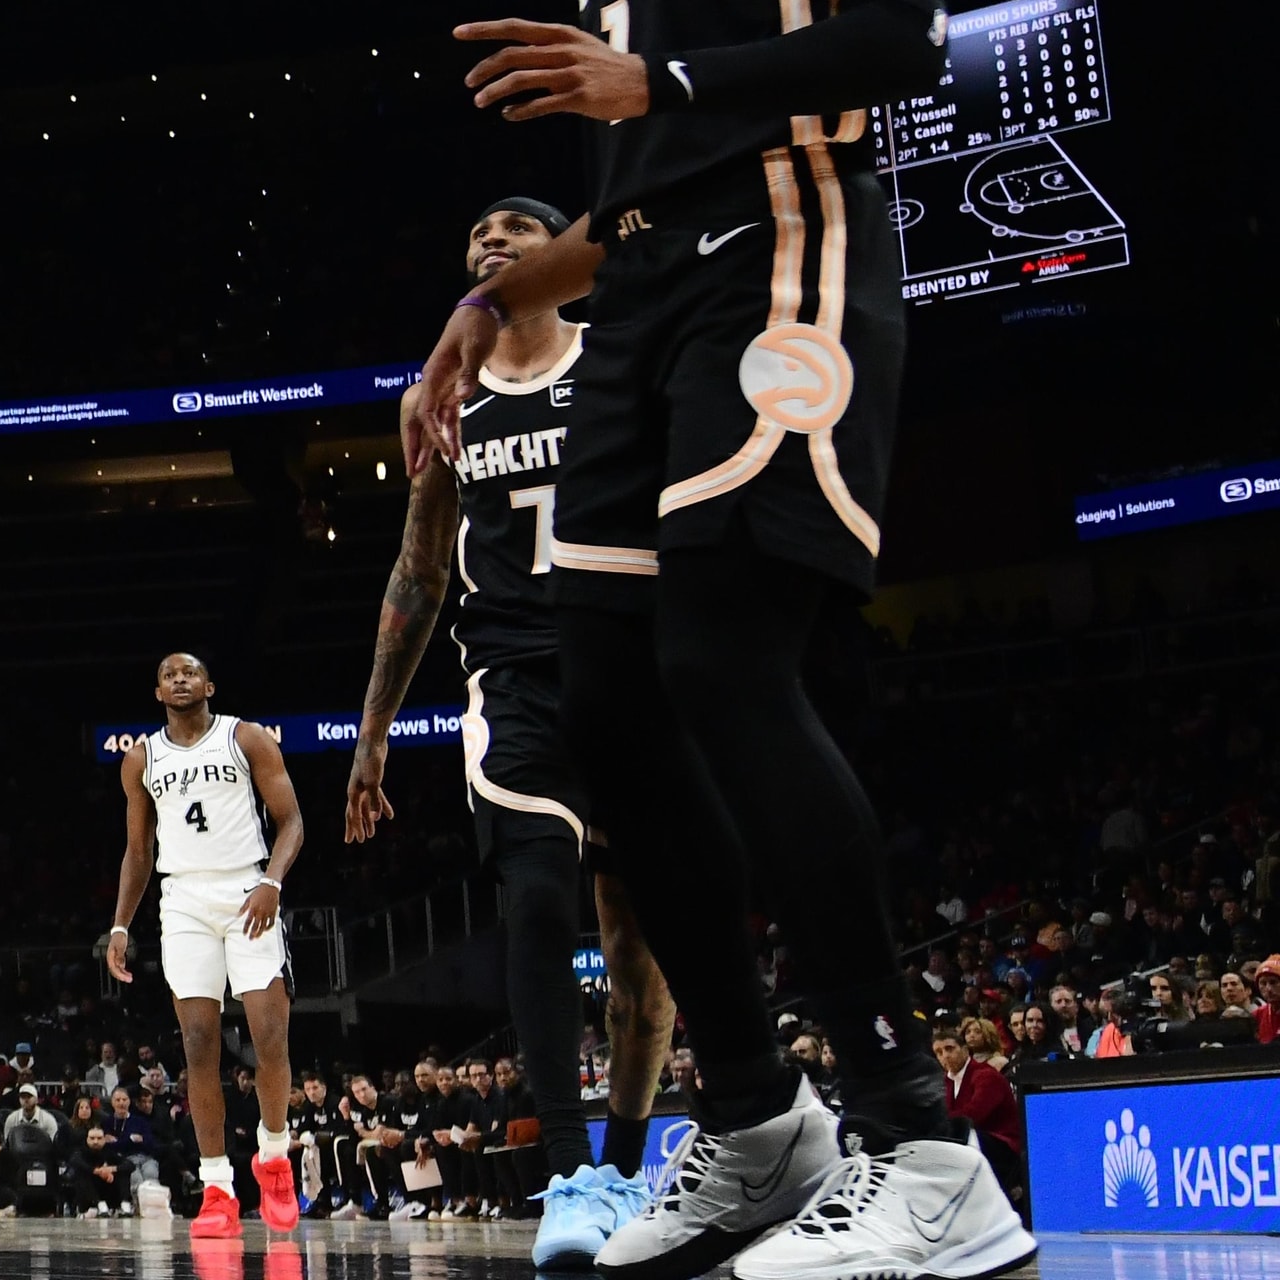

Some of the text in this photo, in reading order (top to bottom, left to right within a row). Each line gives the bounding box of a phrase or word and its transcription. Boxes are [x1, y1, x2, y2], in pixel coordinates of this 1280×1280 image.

[988, 5, 1095, 42] PTS REB AST STL FLS
[994, 22, 1090, 56] 0 3 0 1 1
[996, 38, 1093, 72] 0 2 0 0 0
[998, 54, 1095, 88] 2 1 2 0 0
[893, 86, 1099, 128] 24 Vassell 0 0 1 0 0
[898, 100, 906, 111] 4
[911, 96, 934, 108] Fox
[1022, 86, 1030, 98] 1
[1044, 81, 1053, 93] 0
[1066, 75, 1075, 88] 0
[1088, 70, 1097, 83] 0
[898, 147, 918, 161] 2PT
[1004, 123, 1026, 137] 3PT
[901, 121, 953, 142] 5 Castle
[971, 270, 990, 284] BY
[204, 382, 323, 408] Smurfit Westrock
[374, 376, 404, 389] Paper
[455, 427, 567, 483] PEACHT
[1125, 498, 1176, 516] Solutions
[509, 484, 556, 574] 7
[318, 722, 357, 742] Ken
[152, 764, 238, 799] SPURS
[185, 801, 209, 833] 4
